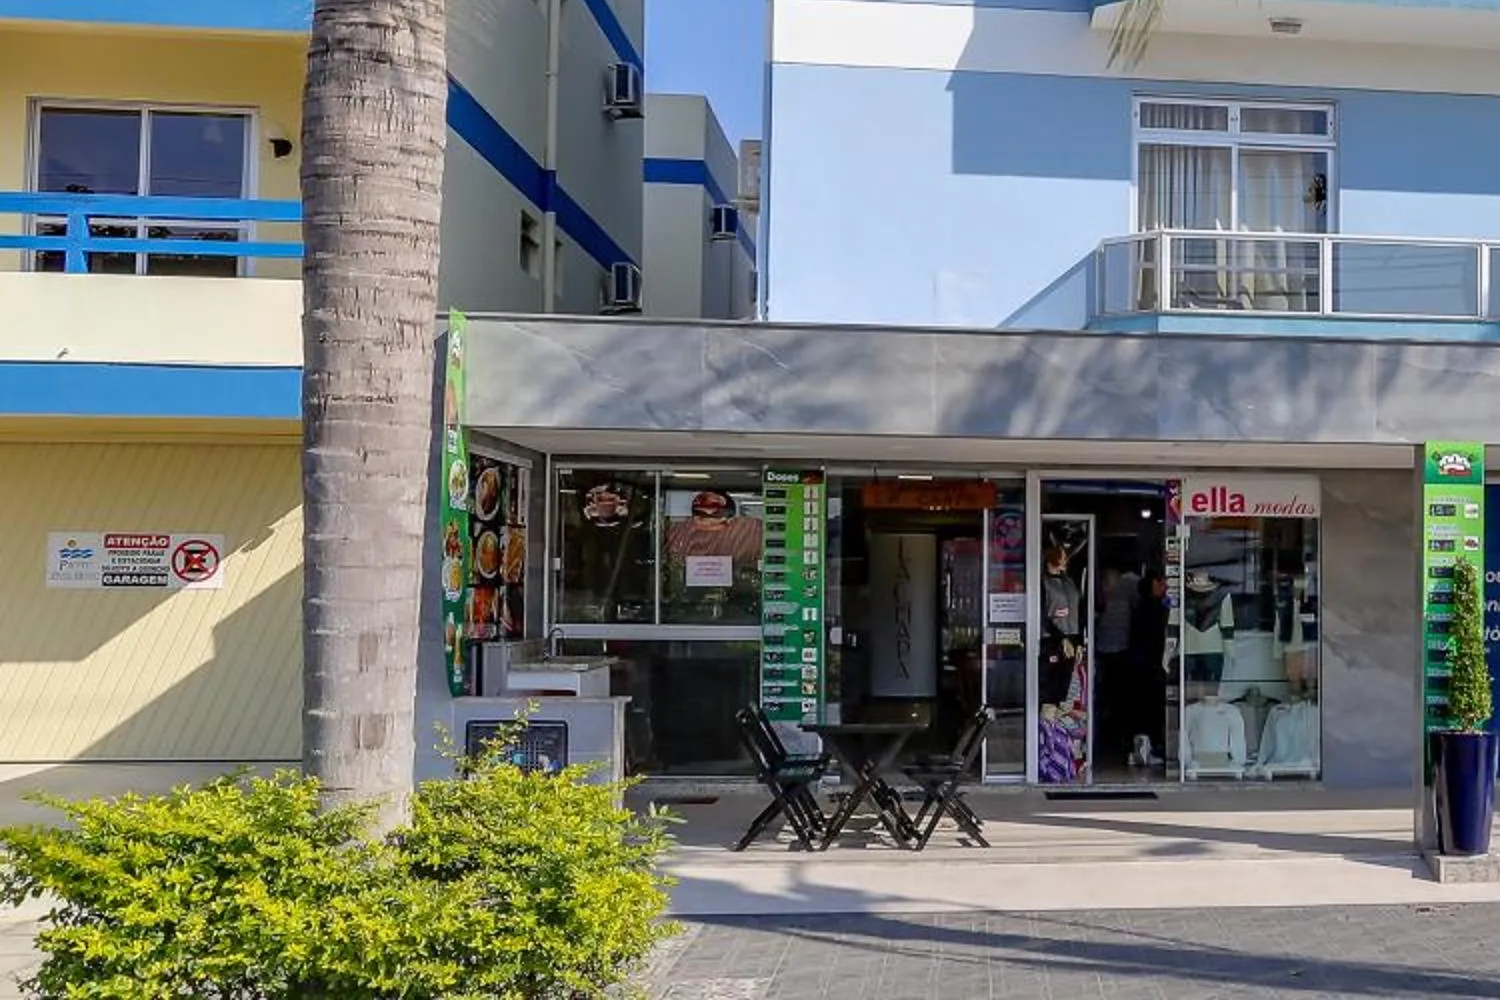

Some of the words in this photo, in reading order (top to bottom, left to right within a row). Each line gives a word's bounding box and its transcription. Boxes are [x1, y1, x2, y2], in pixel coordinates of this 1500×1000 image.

[1191, 486, 1245, 513] ella
[1251, 493, 1315, 514] modas
[107, 535, 168, 547] ATENÇÃO
[103, 575, 167, 585] GARAGEM
